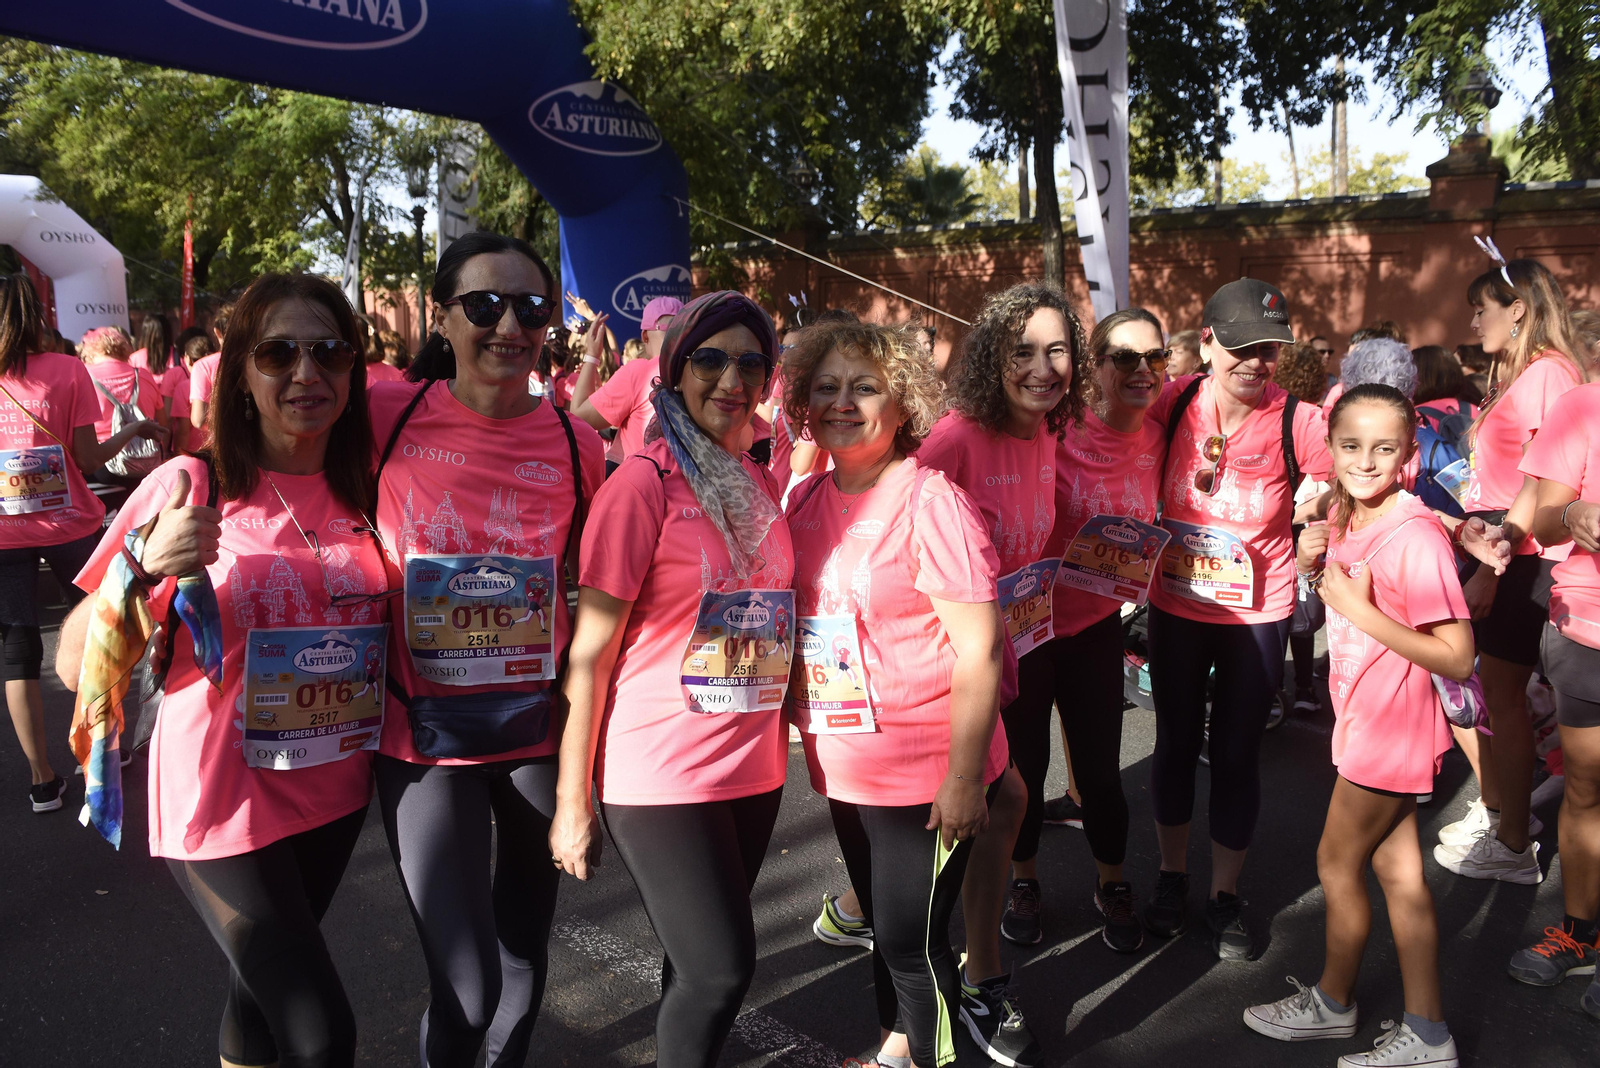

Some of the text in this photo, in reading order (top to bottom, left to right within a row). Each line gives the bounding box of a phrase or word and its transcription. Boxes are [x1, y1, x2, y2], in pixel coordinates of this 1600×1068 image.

[541, 101, 659, 141] ASTURIANA
[40, 230, 95, 244] OYSHO
[75, 302, 125, 315] OYSHO
[403, 443, 466, 466] OYSHO
[1072, 449, 1112, 464] OYSHO
[8, 460, 40, 468] ASTURIANA
[9, 473, 42, 487] 016
[519, 466, 559, 482] ASTURIANA
[986, 473, 1021, 486] OYSHO
[1103, 526, 1137, 542] ASTURIANA
[1094, 543, 1131, 565] 016
[1099, 562, 1117, 573] 4201
[1184, 554, 1221, 571] 016
[416, 574, 441, 583] SUMA
[1064, 573, 1092, 586] OYSHO
[1192, 572, 1212, 580] 4196
[452, 578, 512, 591] ASTURIANA
[1168, 583, 1192, 595] OYSHO
[1013, 598, 1035, 621] 016
[452, 604, 512, 629] 016
[467, 634, 499, 646] 2514
[258, 649, 286, 658] SUMA
[437, 646, 526, 659] CARRERA DE LA MUJER
[723, 636, 767, 659] 016
[298, 652, 353, 667] ASTURIANA
[424, 666, 467, 678] OYSHO
[733, 664, 758, 675] 2515
[708, 677, 739, 686] CARRERA
[749, 677, 757, 685] LA
[757, 676, 774, 685] MUJER
[295, 680, 353, 709] 016
[689, 693, 732, 704] OYSHO
[801, 688, 820, 699] 2516
[813, 701, 820, 709] LA
[310, 711, 339, 725] 2517
[278, 721, 360, 740] CARRERA DE LA MUJER
[256, 748, 307, 760] OYSHO
